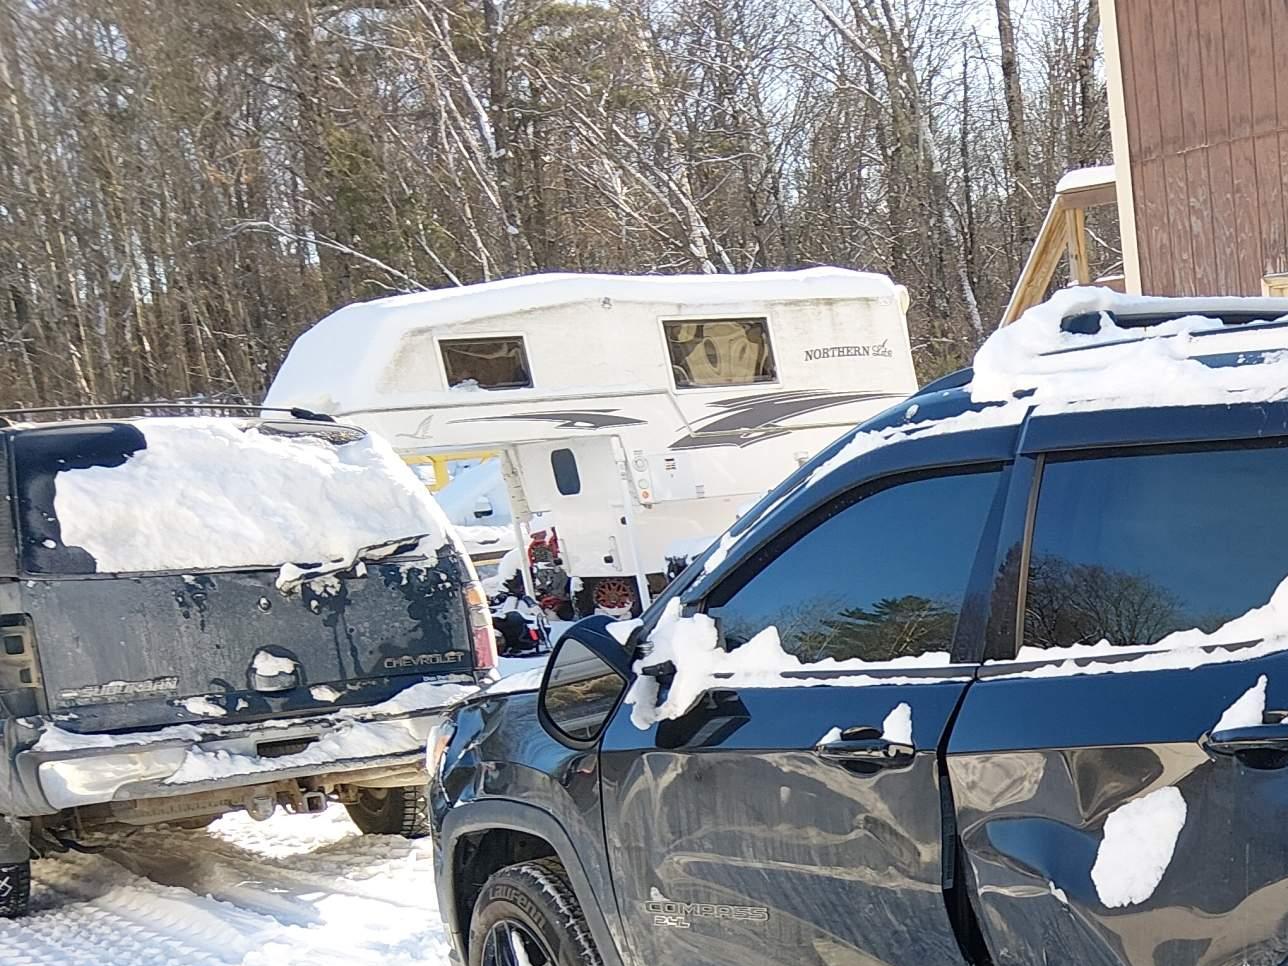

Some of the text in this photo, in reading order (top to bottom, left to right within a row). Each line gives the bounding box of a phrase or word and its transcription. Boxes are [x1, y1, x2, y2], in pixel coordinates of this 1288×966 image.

[803, 345, 870, 362] NORTHERN
[383, 651, 465, 669] CHEVROLET
[644, 900, 770, 921] COMPASS
